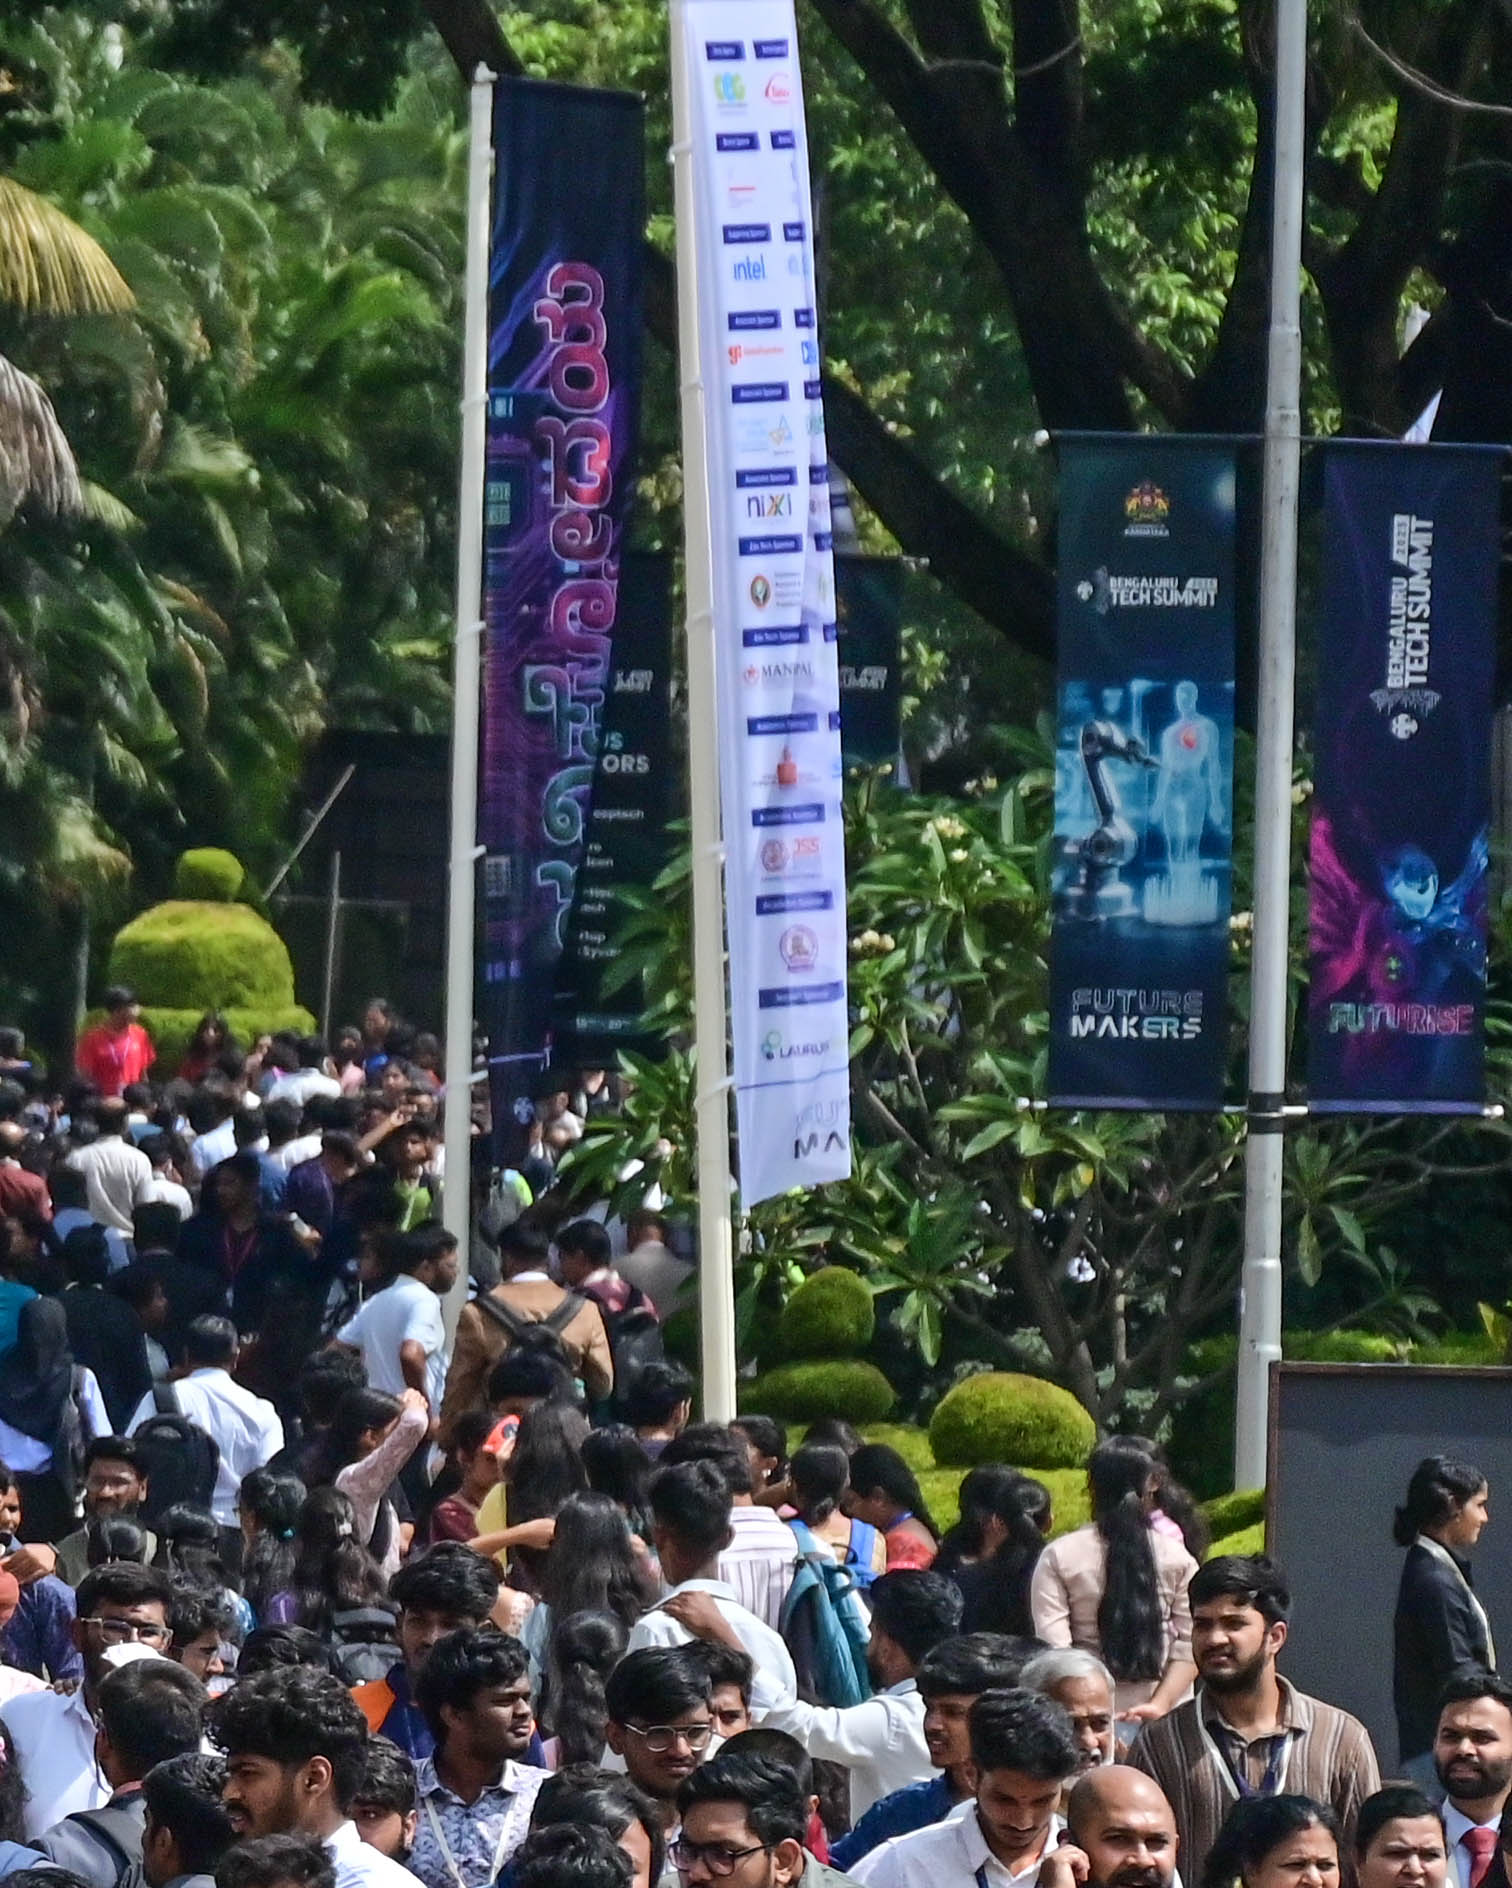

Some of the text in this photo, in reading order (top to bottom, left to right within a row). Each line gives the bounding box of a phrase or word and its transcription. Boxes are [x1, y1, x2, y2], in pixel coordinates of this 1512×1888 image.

[734, 253, 766, 281] intel
[1109, 576, 1179, 589] BENGALURU
[1111, 588, 1218, 607] TECH SUMMIT
[1405, 514, 1434, 689] TECH SUMMIT
[1388, 576, 1409, 689] BENGALURU
[1070, 989, 1204, 1016] FUTURE
[1070, 1015, 1203, 1041] MAKERS
[1329, 1001, 1475, 1036] FUTURISE
